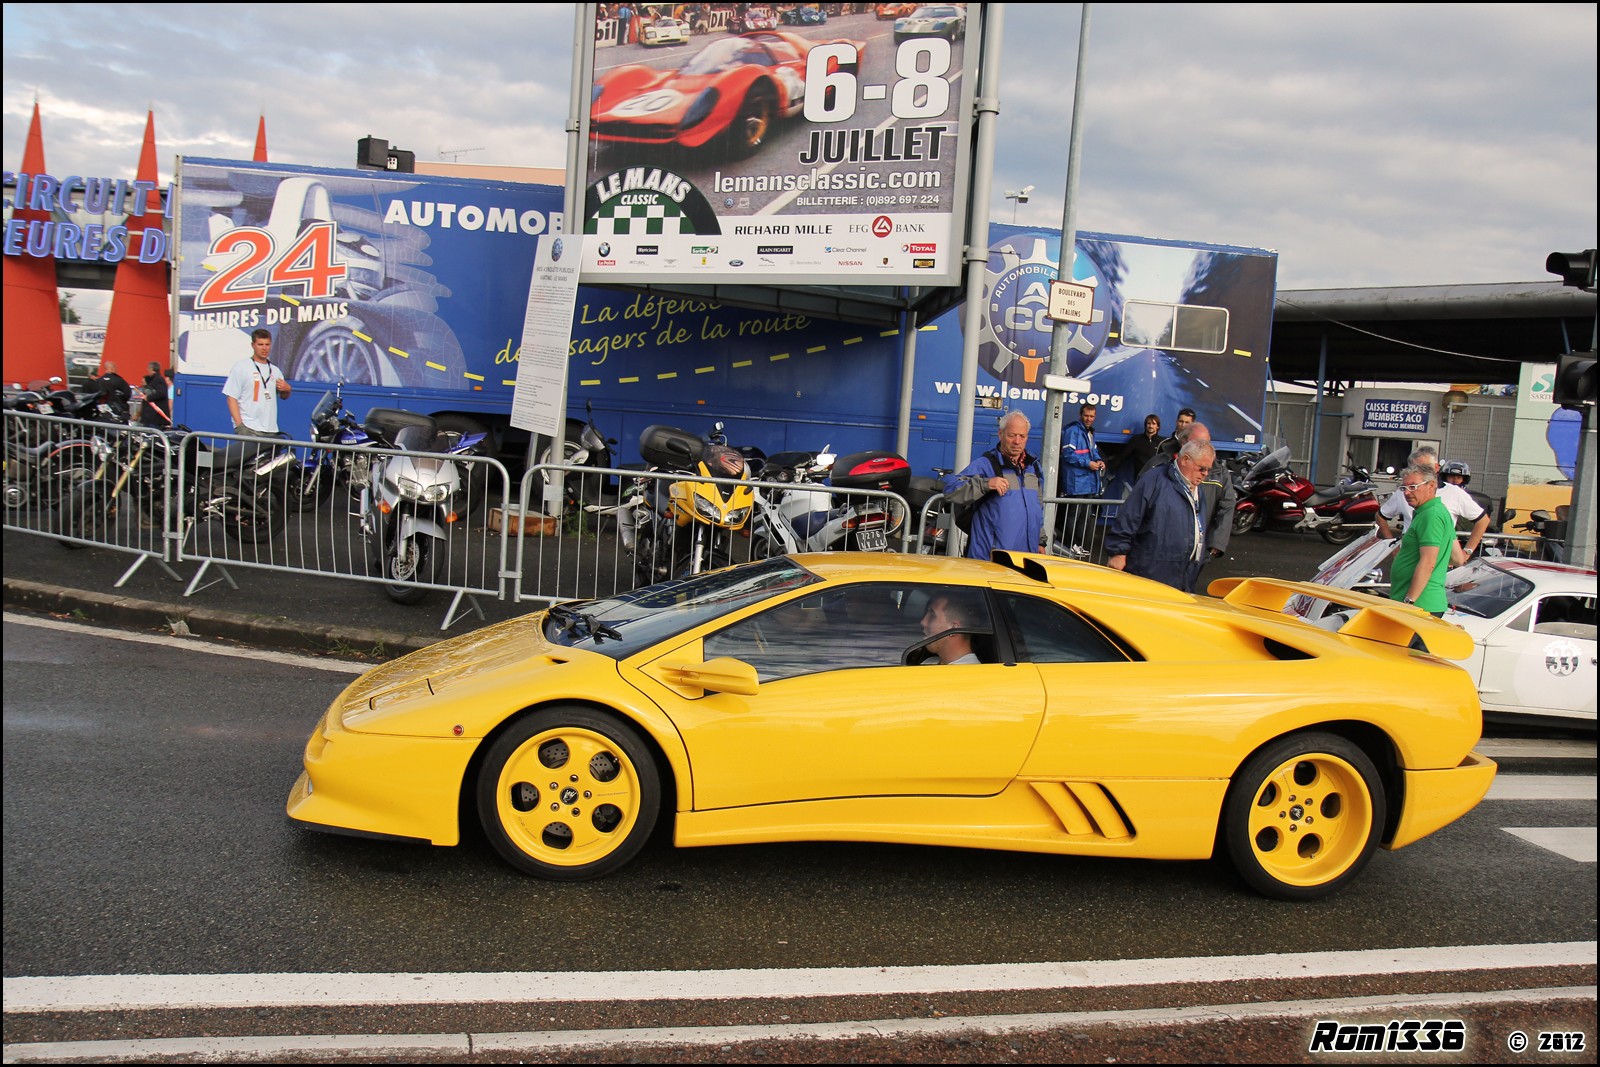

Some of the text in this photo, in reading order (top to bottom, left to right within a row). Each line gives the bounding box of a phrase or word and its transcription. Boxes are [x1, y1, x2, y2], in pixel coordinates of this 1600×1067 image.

[799, 126, 948, 164] JUILLET
[596, 167, 692, 204] LE MANS
[714, 167, 941, 194] lemansclassic.com
[620, 194, 659, 206] CLASSIC
[796, 196, 858, 206] BILLETTERIE
[866, 195, 897, 206] (0)892
[899, 195, 918, 204] 697
[920, 194, 940, 204] 224
[384, 199, 564, 236] AUTOMOB
[849, 223, 926, 234] EFG BANK
[734, 224, 833, 235] RICHARD MILLE
[139, 227, 174, 264] D
[194, 221, 348, 310] 24
[995, 266, 1059, 298] AUTOMOBILE
[1058, 288, 1086, 299] BOULEVARD
[193, 302, 349, 332] HEURES DU MANS
[580, 303, 619, 325] La
[1059, 308, 1081, 318] ITALIENS
[656, 320, 693, 346] de
[701, 315, 731, 341] la
[738, 313, 812, 337] route
[1365, 401, 1427, 414] CAISSE RÉSERVÉE
[1368, 412, 1422, 423] MEMBRES ACO
[1399, 423, 1425, 431] MEMBERS)
